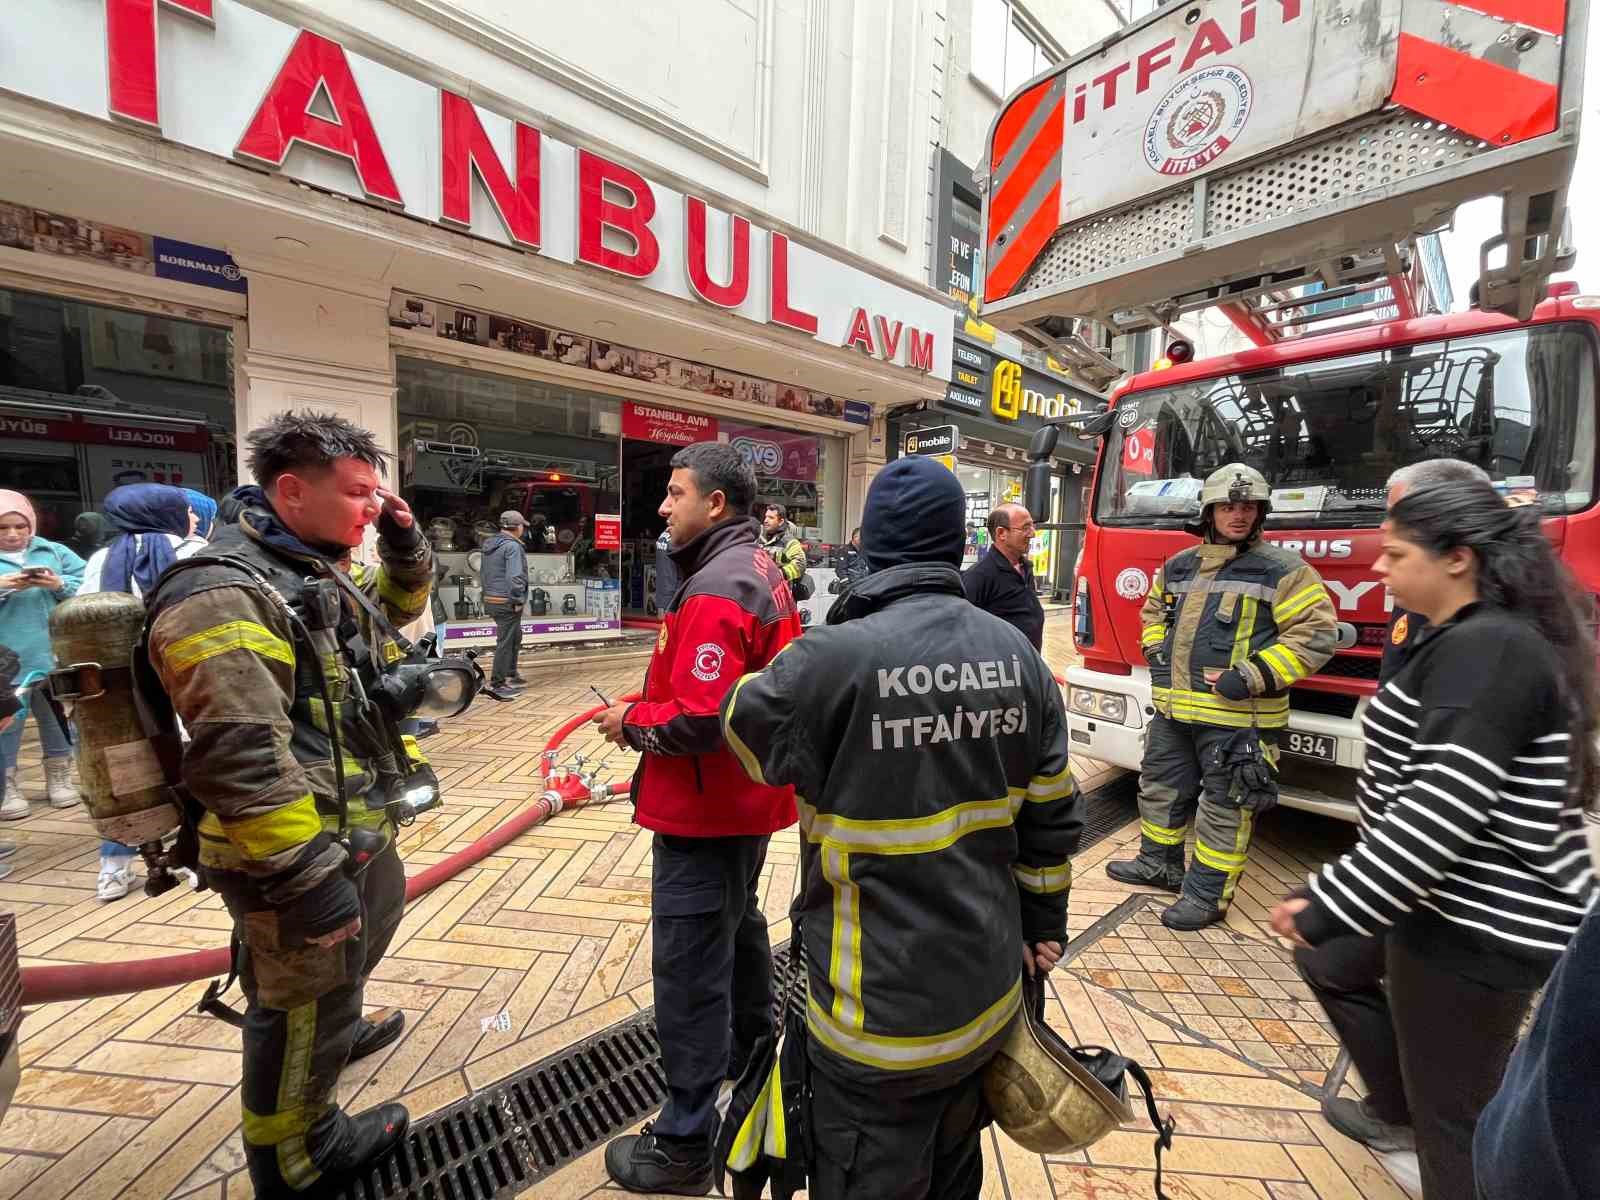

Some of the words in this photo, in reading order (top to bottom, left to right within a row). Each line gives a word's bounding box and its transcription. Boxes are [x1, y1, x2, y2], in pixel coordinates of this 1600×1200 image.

[159, 254, 222, 274] KORKMAZ
[845, 306, 934, 372] AVM
[957, 348, 982, 365] TELEFON
[957, 371, 978, 385] TABLET
[967, 395, 982, 407] SAAT
[687, 416, 709, 428] AVM
[1121, 411, 1136, 424] 60
[919, 435, 951, 448] mobile
[877, 654, 1021, 698] KOCAELİ
[871, 701, 1027, 750] İTFAİYESİ
[1289, 734, 1326, 756] 934
